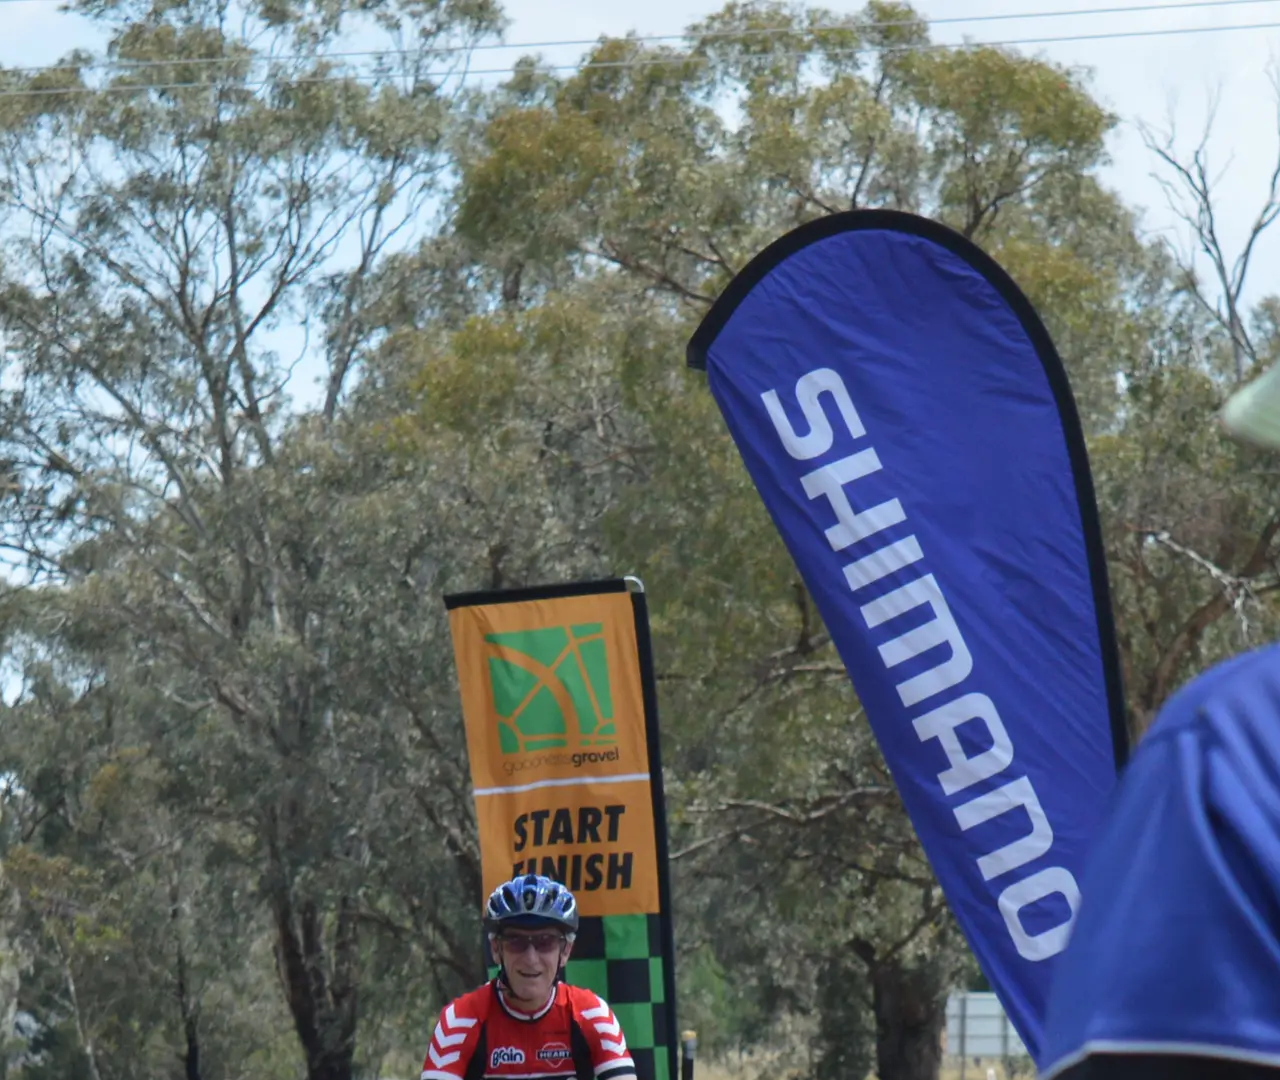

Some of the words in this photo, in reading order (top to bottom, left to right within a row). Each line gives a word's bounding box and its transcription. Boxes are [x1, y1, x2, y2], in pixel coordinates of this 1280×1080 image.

[760, 367, 1082, 962] SHIMANO
[513, 805, 626, 852] START
[491, 1046, 525, 1068] Brain
[539, 1050, 570, 1059] HEART
